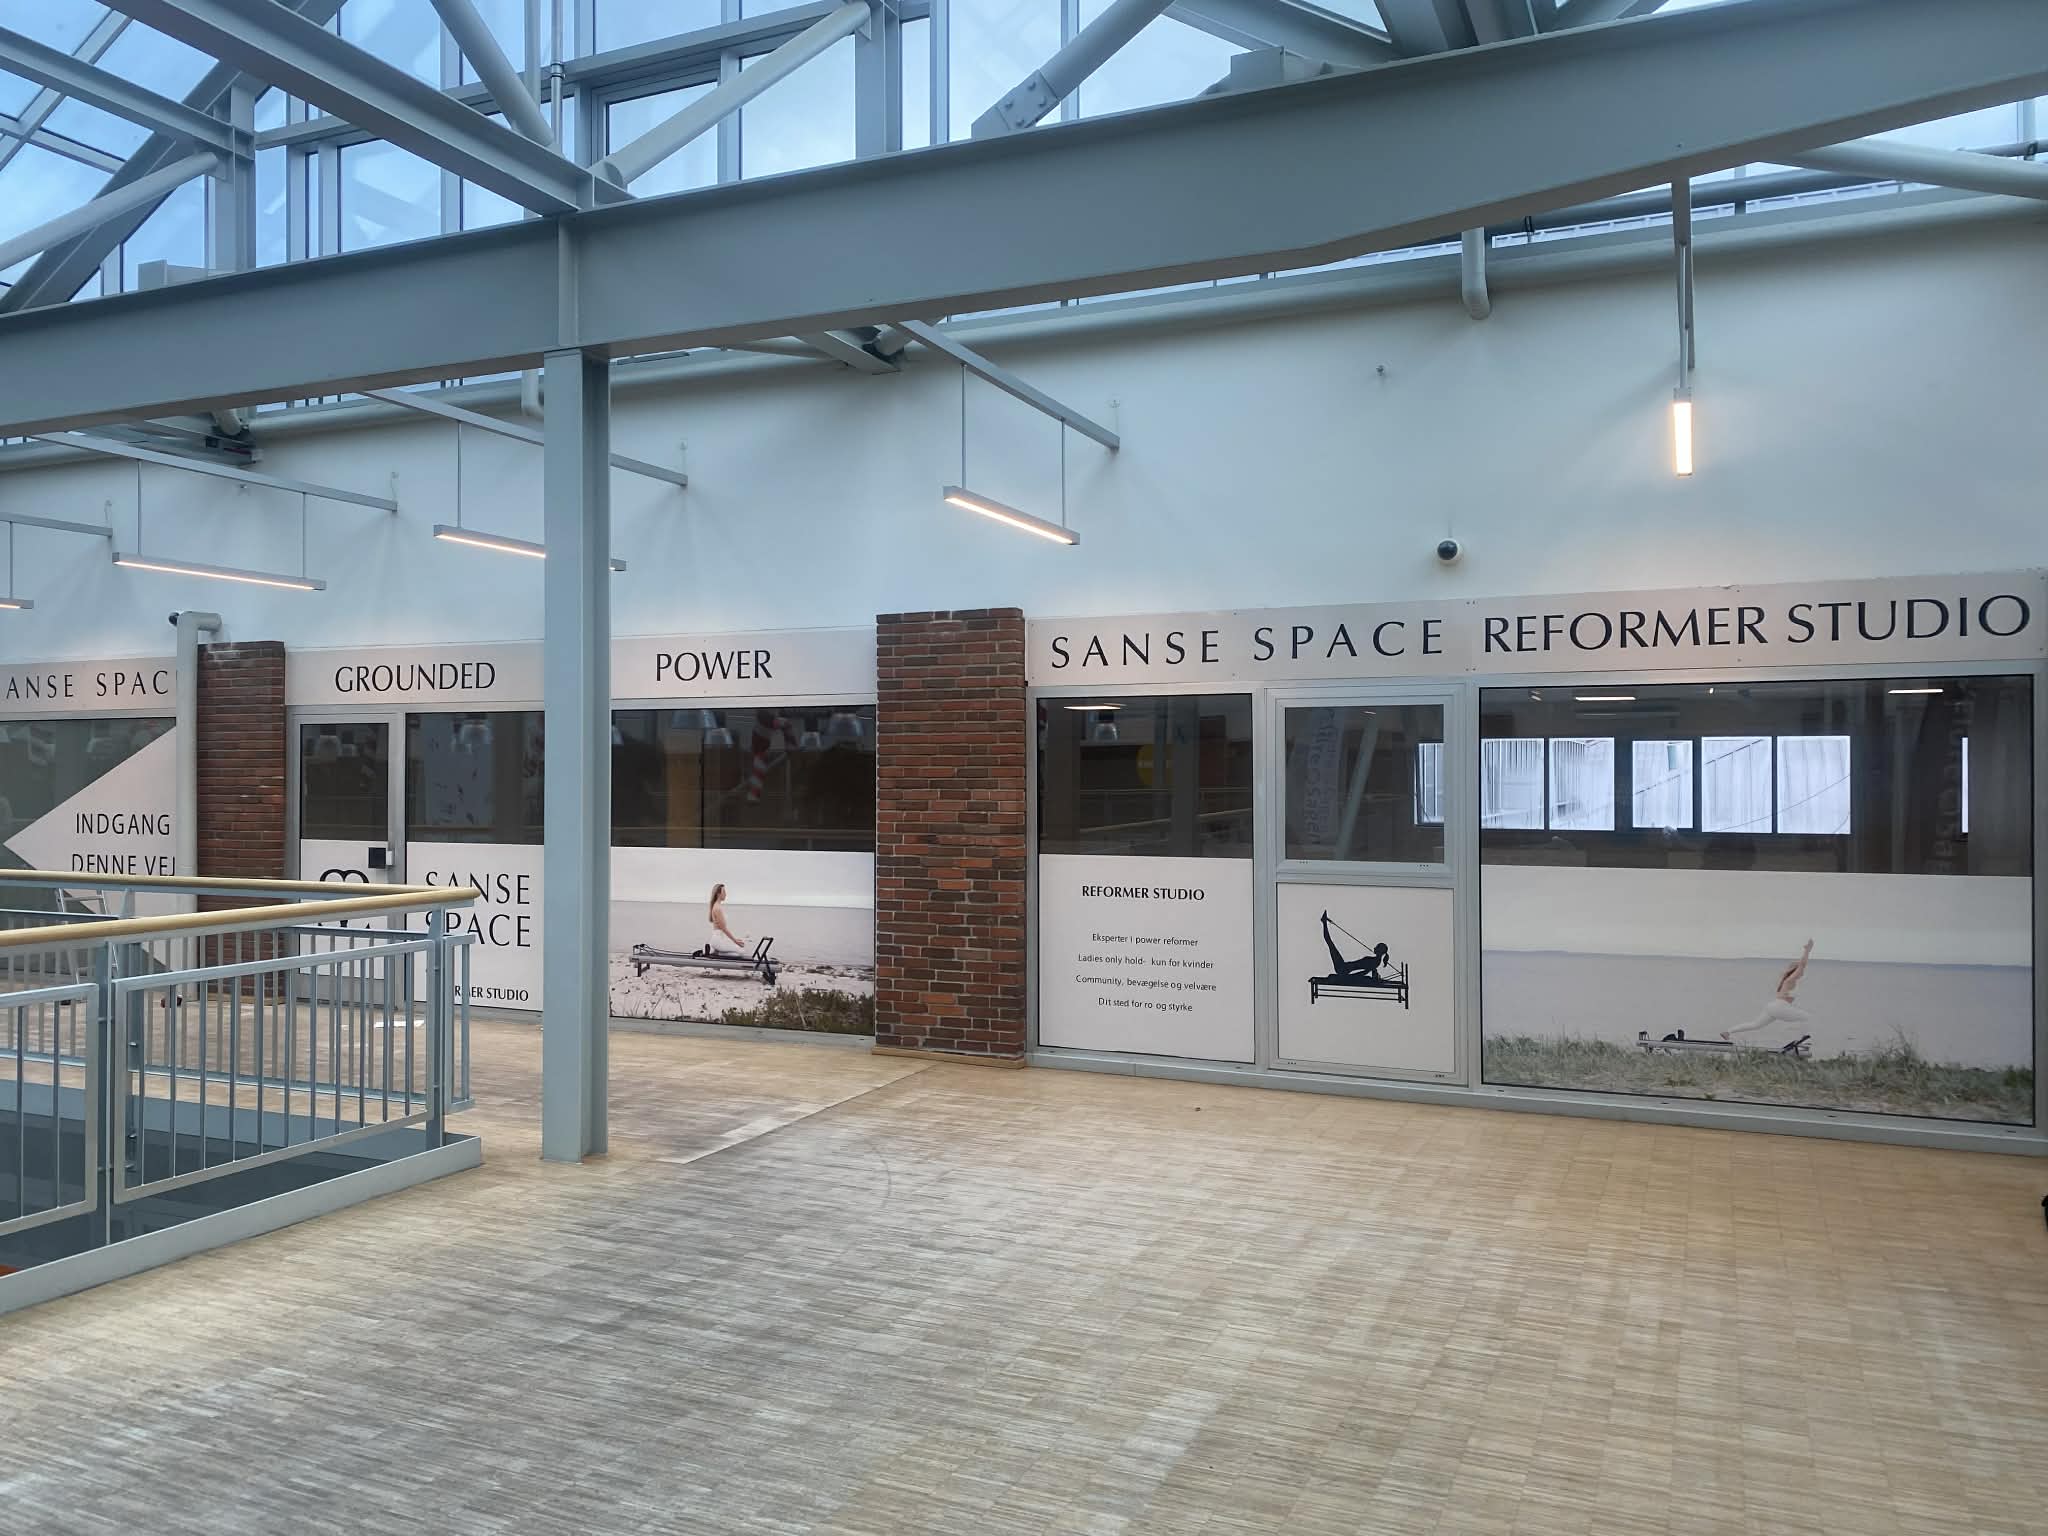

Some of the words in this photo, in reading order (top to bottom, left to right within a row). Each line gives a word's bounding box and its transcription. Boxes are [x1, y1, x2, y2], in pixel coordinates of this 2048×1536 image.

[1051, 630, 1220, 669] SANSE
[1253, 619, 1442, 661] SPACE
[1484, 605, 1769, 653] REFORMER
[1787, 594, 2032, 643] STUDIO
[655, 650, 773, 682] POWER
[5, 674, 74, 699] ANSE
[96, 670, 170, 697] SPAC
[334, 662, 497, 693] GROUNDED
[76, 813, 170, 835] INDGANG
[71, 853, 137, 875] DENNE
[144, 855, 176, 876] VEJ
[1082, 885, 1149, 899] REFORMER
[1153, 887, 1205, 901] STUDIO
[1092, 933, 1128, 944] Eksperter
[1135, 936, 1161, 945] power
[1163, 937, 1198, 947] reformer
[1078, 953, 1103, 963] Ladies
[1105, 954, 1123, 965] only
[1151, 957, 1167, 967] kun
[1169, 958, 1180, 967] for
[1182, 959, 1214, 969] kvinder
[1127, 977, 1169, 989] bevægelse
[1170, 981, 1182, 991] og
[1183, 981, 1217, 991] velvære
[486, 987, 529, 1001] STUDIO
[1098, 997, 1112, 1006] Dit
[1113, 998, 1130, 1007] sted
[1131, 999, 1143, 1008] for
[1144, 1001, 1153, 1009] ro
[1155, 1002, 1167, 1012] og
[1168, 1001, 1193, 1012] styrke
